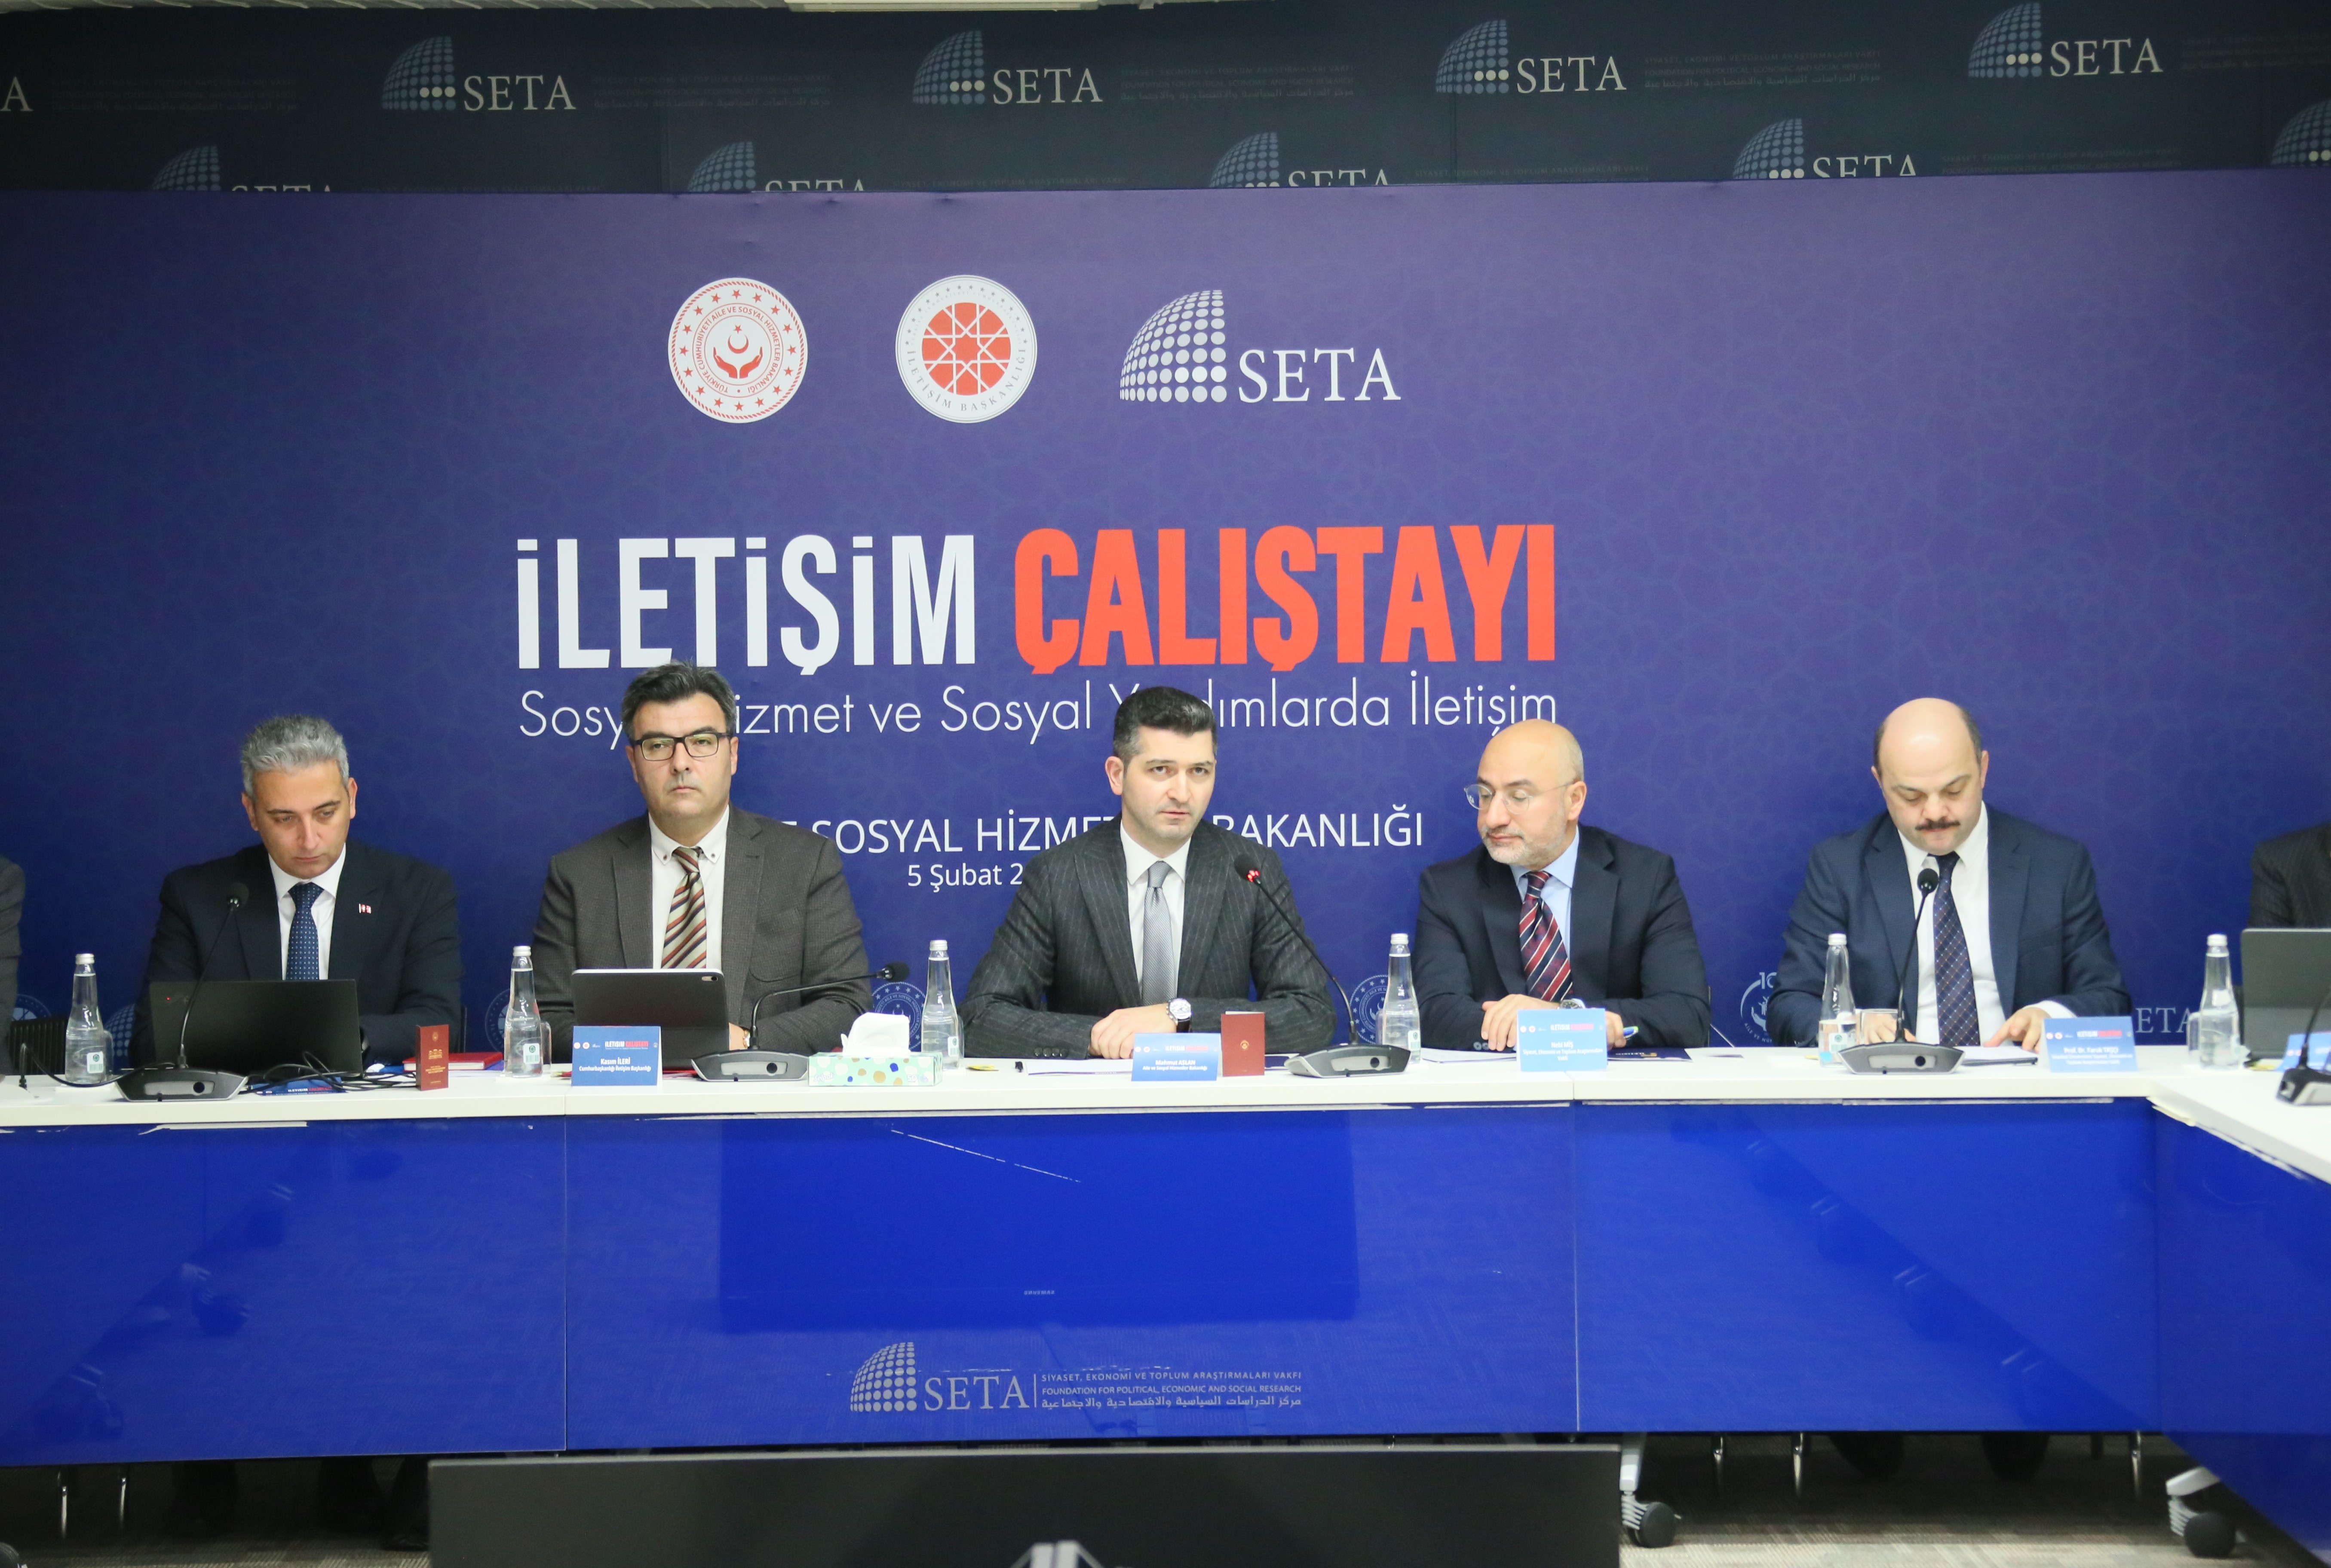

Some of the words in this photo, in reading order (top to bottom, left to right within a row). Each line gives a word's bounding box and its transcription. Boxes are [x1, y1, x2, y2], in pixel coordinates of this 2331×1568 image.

[1517, 56, 1627, 94] SETA
[2050, 38, 2163, 77] SETA
[464, 75, 576, 111] SETA
[993, 67, 1103, 104] SETA
[712, 309, 727, 322] AİLE
[739, 306, 764, 322] SOSYAL
[696, 319, 712, 370] CUMHURİYETİ
[765, 320, 781, 361] HİZMETLER
[702, 370, 728, 393] TÜRKİYE
[748, 362, 779, 393] BAKANLIĞI
[907, 349, 952, 409] İLETİŞİM
[961, 348, 1026, 411] BAŞKANLIĞI
[1239, 347, 1401, 403] SETA
[1015, 524, 1555, 674] ÇALIŞTAYI
[519, 690, 623, 750] Sosy
[735, 695, 854, 733] izmet
[868, 703, 921, 733] ve
[941, 680, 1091, 745] Sosyal
[1411, 670, 1556, 736] İletişim
[908, 864, 921, 887] 5
[930, 863, 1002, 893] Şubat
[2135, 1007, 2190, 1033] ETA
[924, 1375, 1030, 1411] SETA
[1042, 1387, 1096, 1395] FOUNDATION
[1162, 1385, 1206, 1393] ECONOMIC
[1259, 1384, 1301, 1393] RESEARCH
[1086, 1372, 1131, 1381] EKONOMİ
[1150, 1372, 1189, 1380] TOPLUM
[1193, 1371, 1270, 1380] ARAŞTIRMALARI
